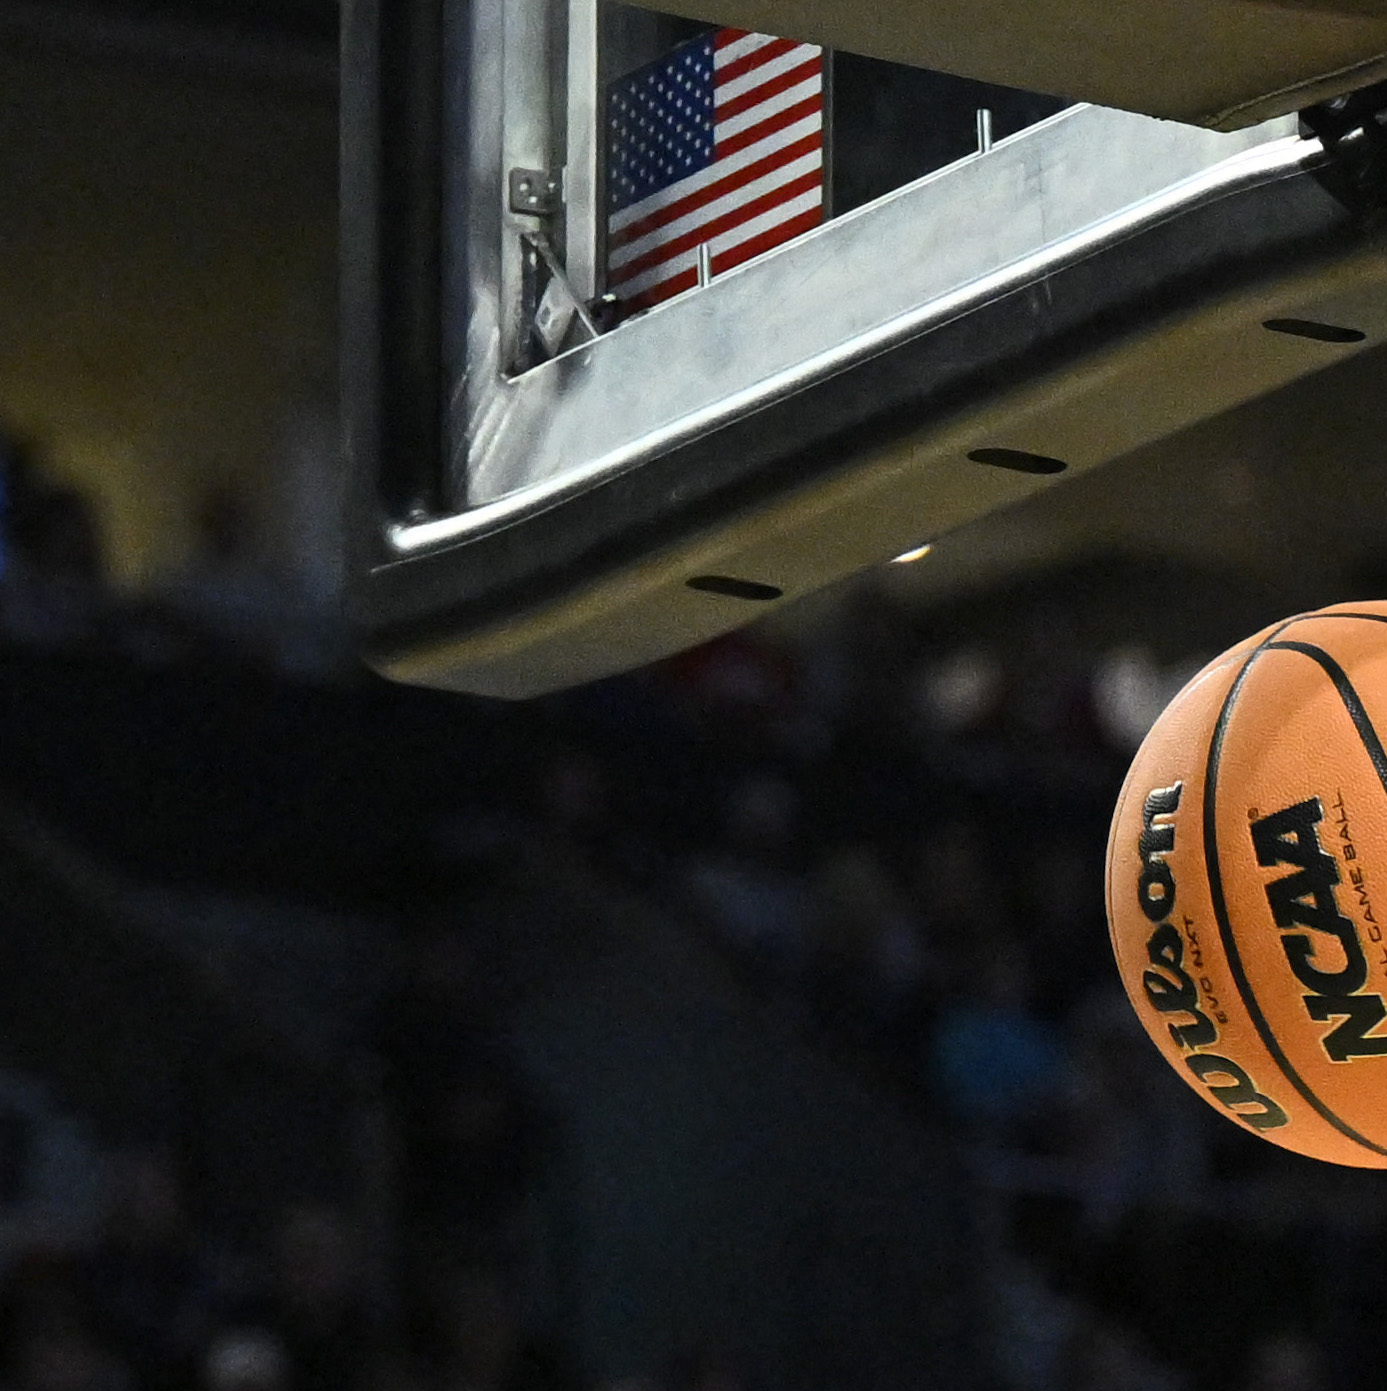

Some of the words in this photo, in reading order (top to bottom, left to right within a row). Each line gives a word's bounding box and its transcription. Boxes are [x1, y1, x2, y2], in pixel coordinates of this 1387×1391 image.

[1333, 788, 1357, 861] BALL
[1349, 866, 1384, 942] GAME
[1137, 780, 1291, 1133] Wilson
